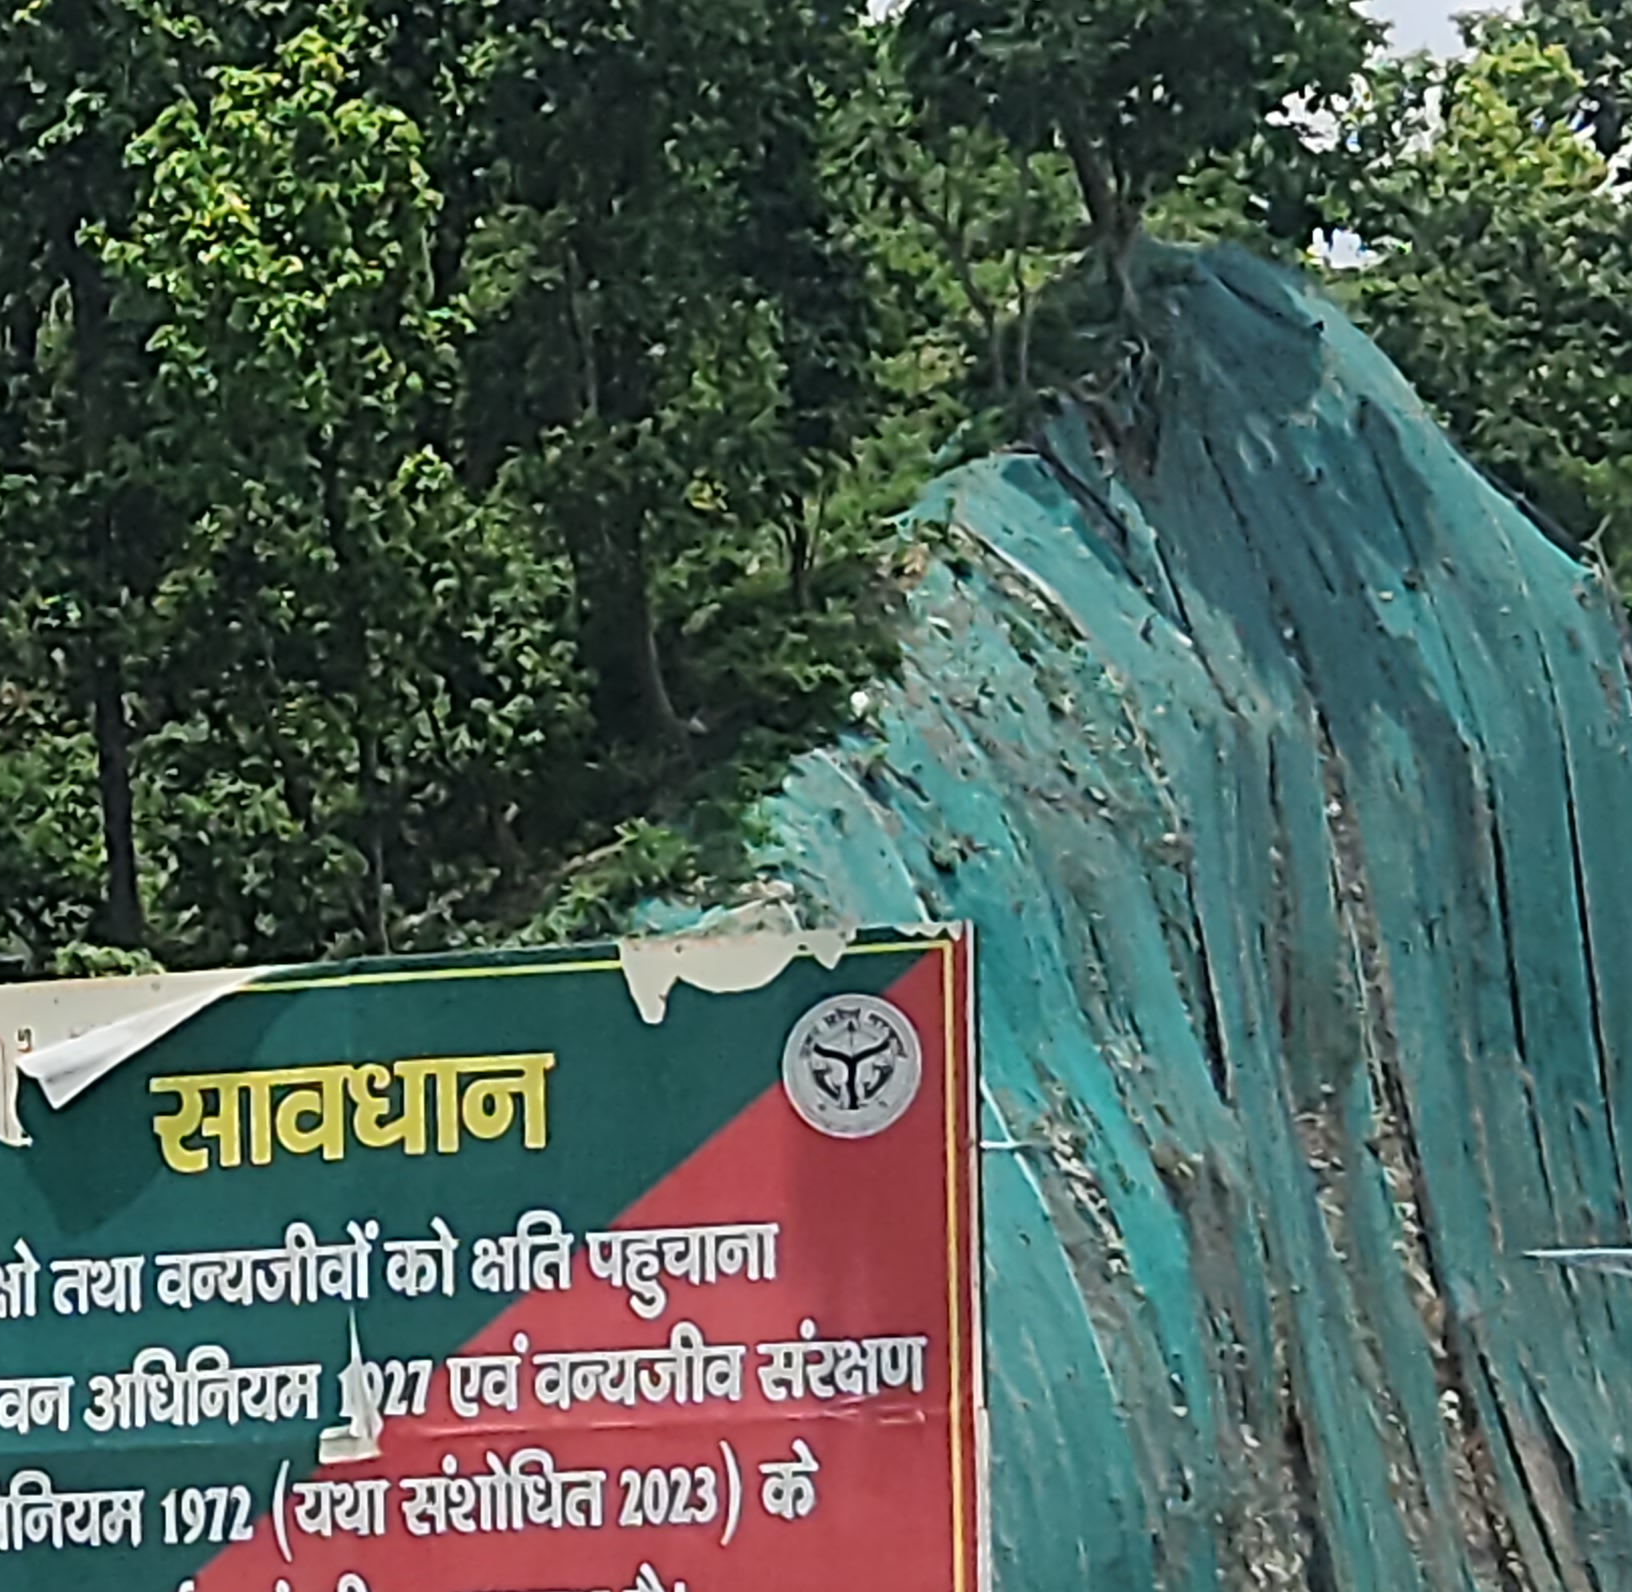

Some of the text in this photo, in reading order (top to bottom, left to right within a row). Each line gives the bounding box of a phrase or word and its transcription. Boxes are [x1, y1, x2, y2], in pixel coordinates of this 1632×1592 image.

[149, 1052, 555, 1173] सावधान
[49, 1255, 145, 1315] तथा
[155, 1219, 379, 1309] वन्यजीवों
[383, 1217, 459, 1297] को
[471, 1209, 574, 1293] क्षति
[585, 1223, 779, 1320] पहुचाना
[83, 1345, 321, 1432] अधिनियम
[447, 1332, 529, 1417] एवं
[533, 1320, 745, 1409] वन्यजीव
[756, 1318, 927, 1401] संरक्षण
[161, 1487, 254, 1545] 1972
[400, 1448, 606, 1536] संशोधित
[759, 1438, 820, 1520] के
